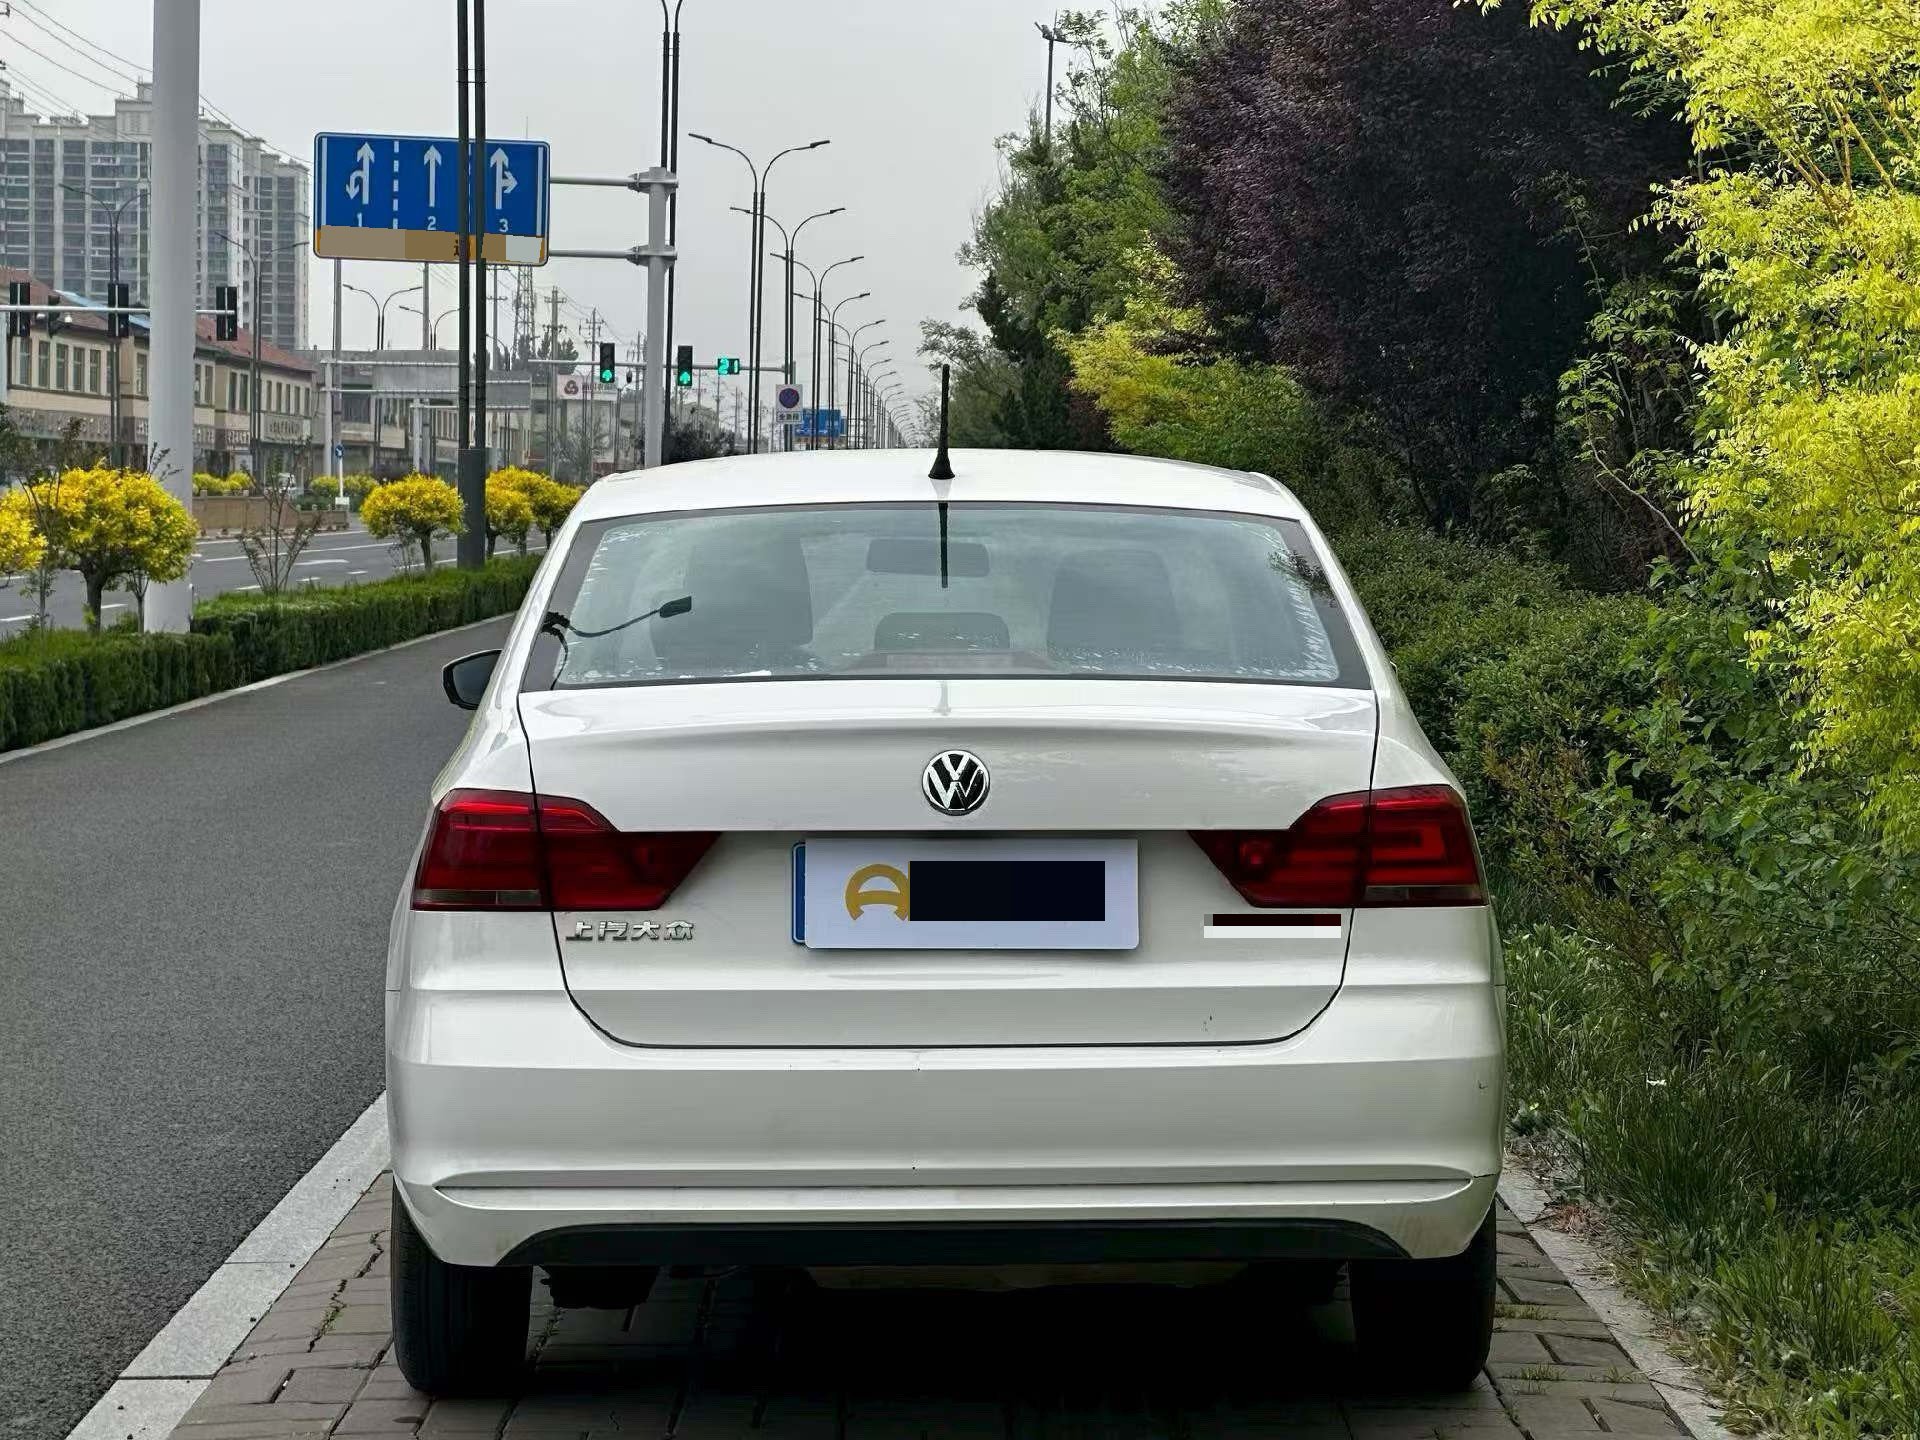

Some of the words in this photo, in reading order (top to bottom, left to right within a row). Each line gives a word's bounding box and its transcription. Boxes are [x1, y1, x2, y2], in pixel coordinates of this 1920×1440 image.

[356, 212, 363, 228] 1
[427, 215, 437, 231] 2
[498, 218, 509, 232] 3
[565, 920, 694, 941] 上汽大众
